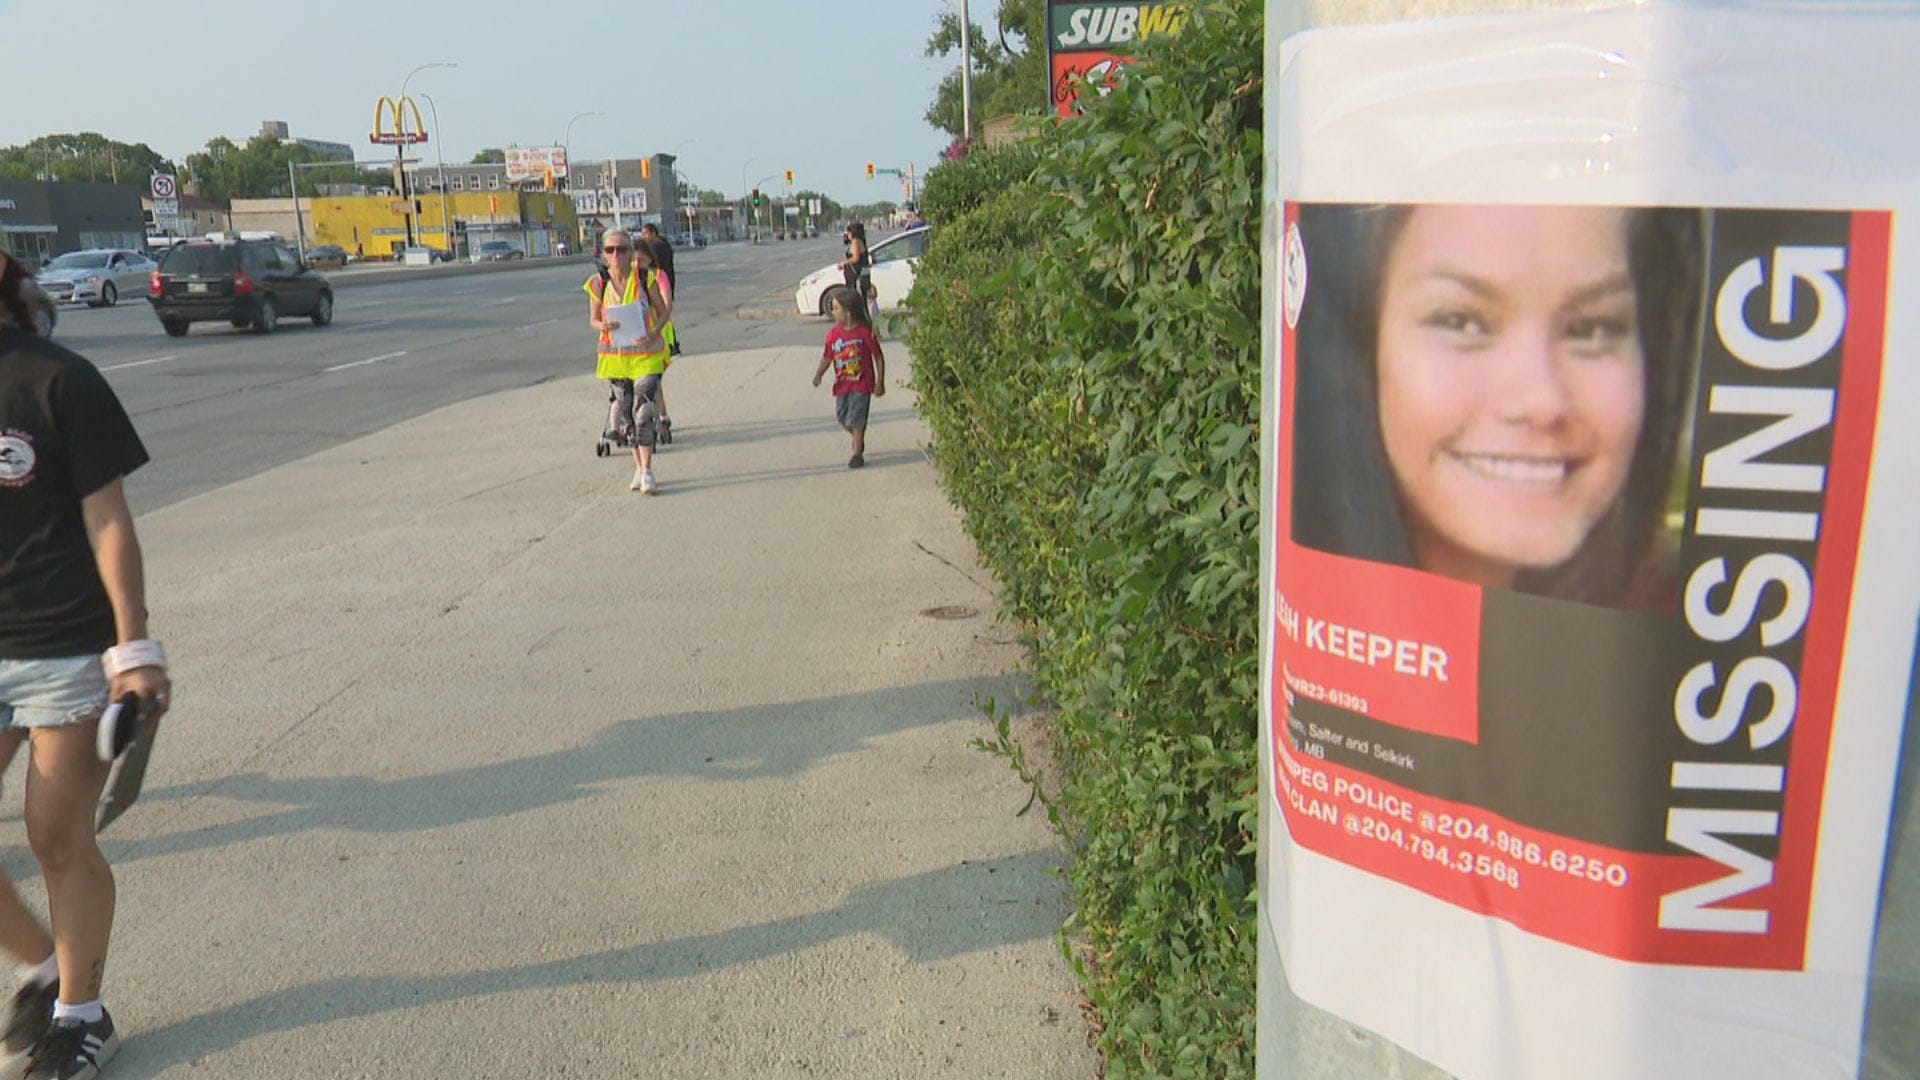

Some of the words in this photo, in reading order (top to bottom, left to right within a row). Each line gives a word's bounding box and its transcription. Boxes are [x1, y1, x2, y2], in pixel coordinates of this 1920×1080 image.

[1057, 5, 1189, 47] SUBW
[1658, 246, 1847, 934] MISSING
[1306, 616, 1448, 681] KEEPER
[1304, 740, 1325, 759] MB
[1309, 723, 1343, 746] Salter
[1345, 736, 1369, 754] and
[1373, 744, 1416, 770] Selkirk
[1333, 777, 1413, 824] POLICE
[1418, 810, 1628, 888] @204.986.6250
[1342, 813, 1520, 890] @204.794.3568
